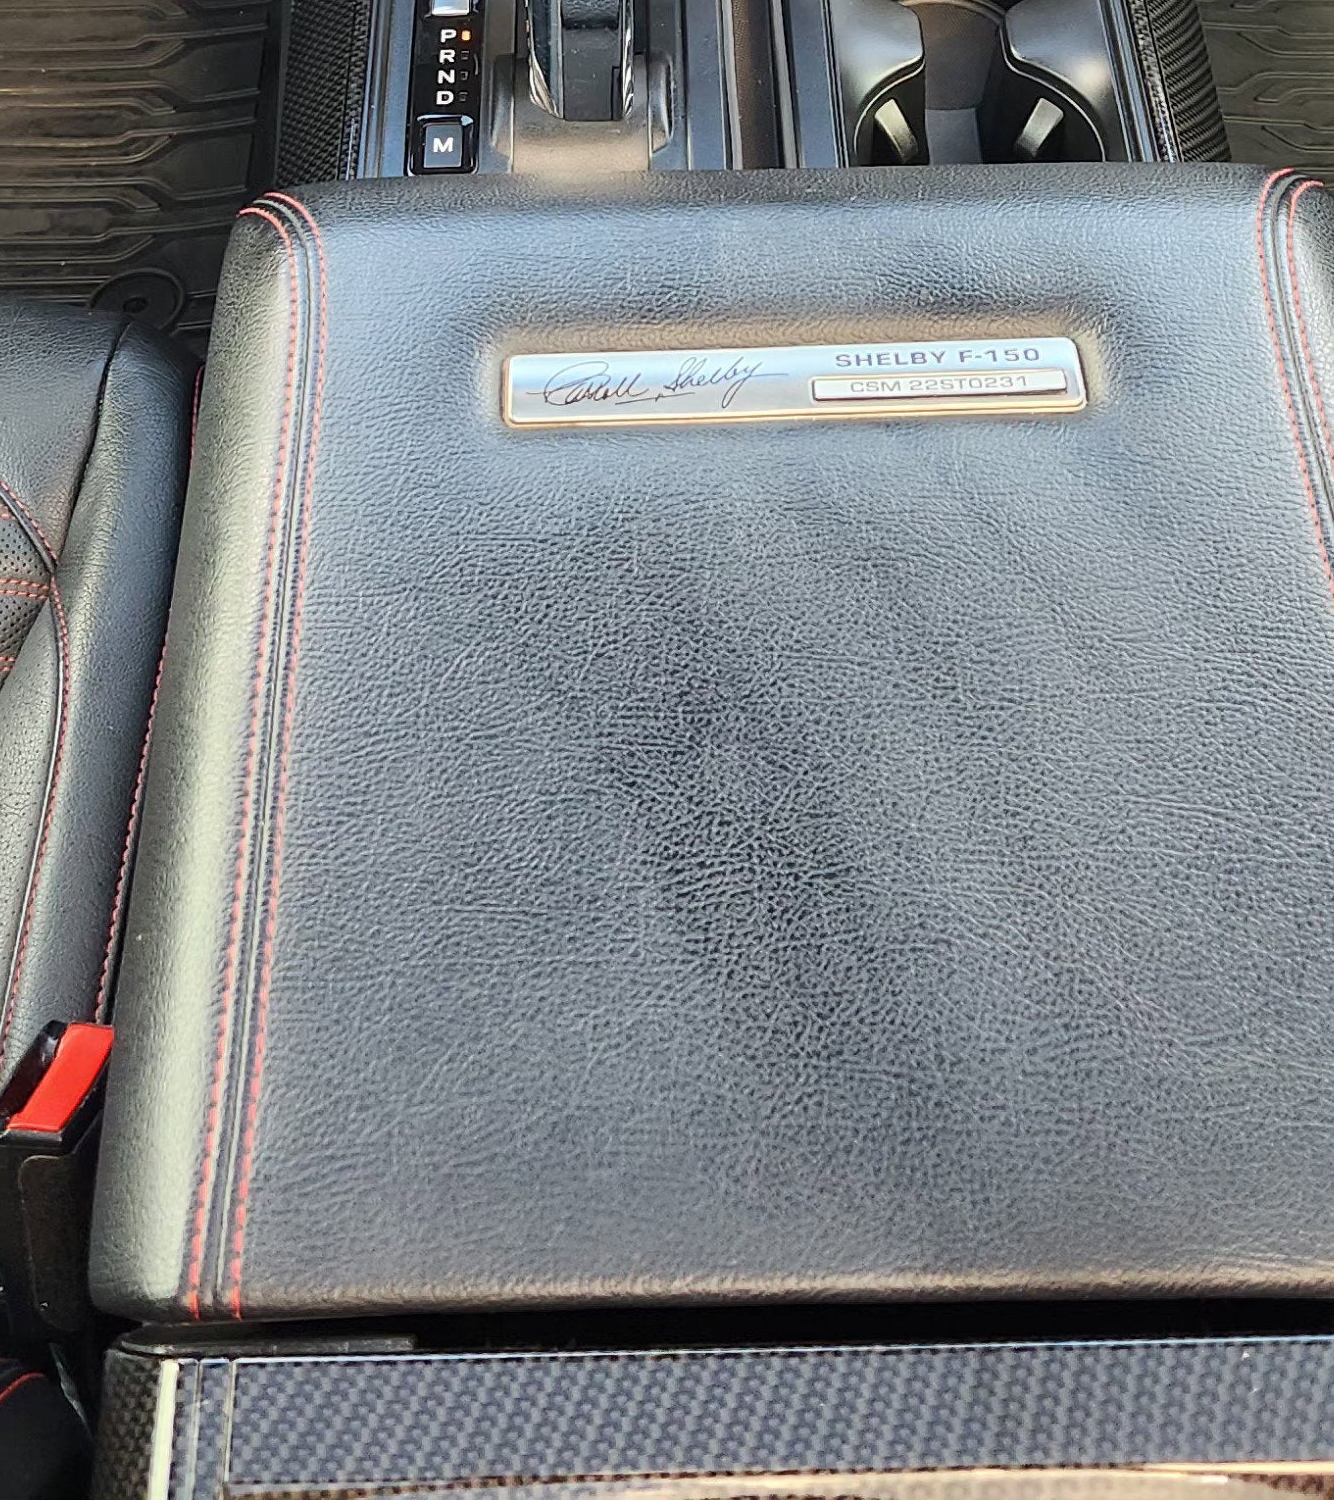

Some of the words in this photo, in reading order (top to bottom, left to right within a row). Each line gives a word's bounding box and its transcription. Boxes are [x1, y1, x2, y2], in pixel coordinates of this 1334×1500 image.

[440, 28, 457, 43] P
[439, 49, 455, 63] R
[437, 69, 455, 84] N
[436, 90, 455, 105] D
[433, 136, 454, 153] M
[834, 350, 947, 368] SHELBY
[959, 347, 1040, 363] F-150
[850, 379, 901, 393] CSM
[909, 375, 1028, 392] 22ST0231
